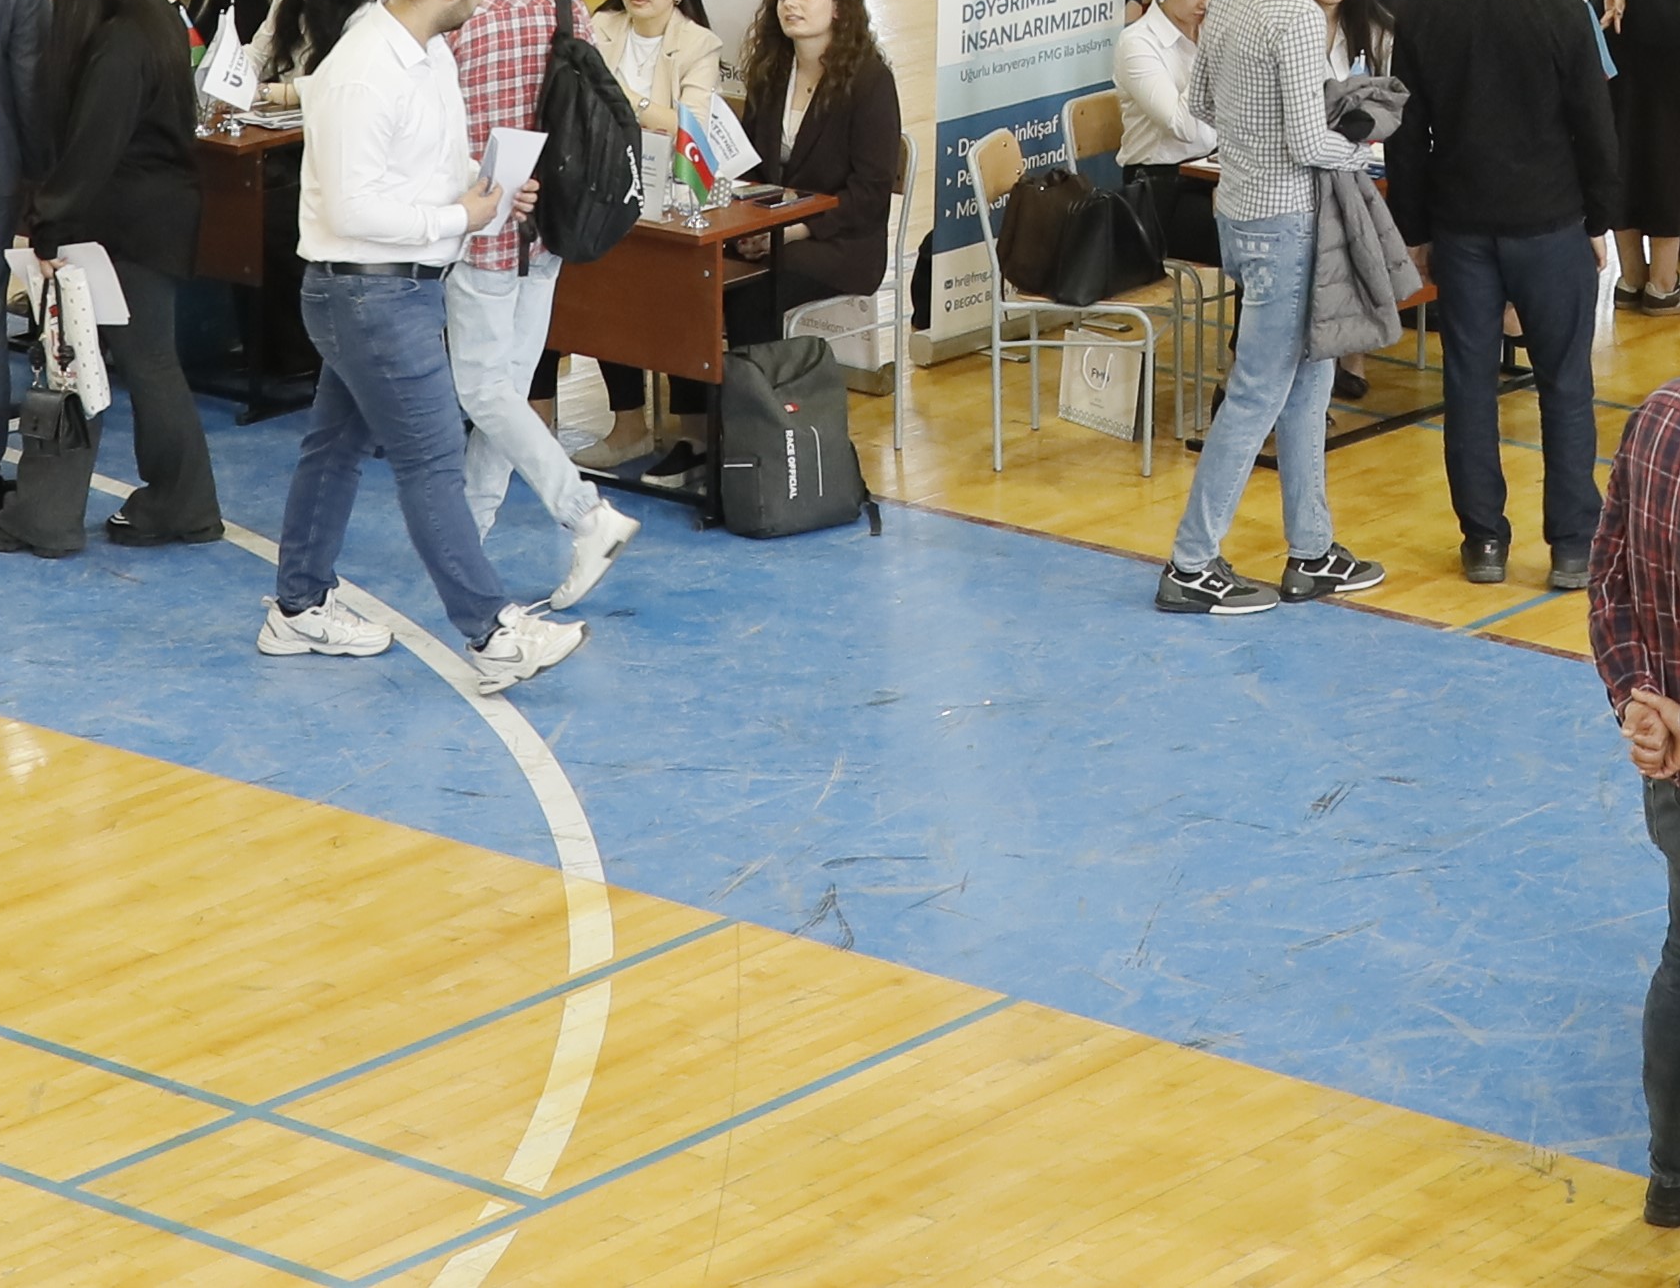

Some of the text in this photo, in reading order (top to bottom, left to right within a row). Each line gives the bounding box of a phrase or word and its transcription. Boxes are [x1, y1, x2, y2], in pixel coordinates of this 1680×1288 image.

[961, 1, 1113, 54] İNSANLARIMIZDIR!
[960, 67, 991, 83] Uğurlu
[992, 55, 1036, 77] karyeraya
[1038, 49, 1062, 65] FMG
[1015, 114, 1059, 141] inkişaf
[953, 293, 983, 311] BEGOC
[785, 429, 798, 499] RACE OFFICIAL
